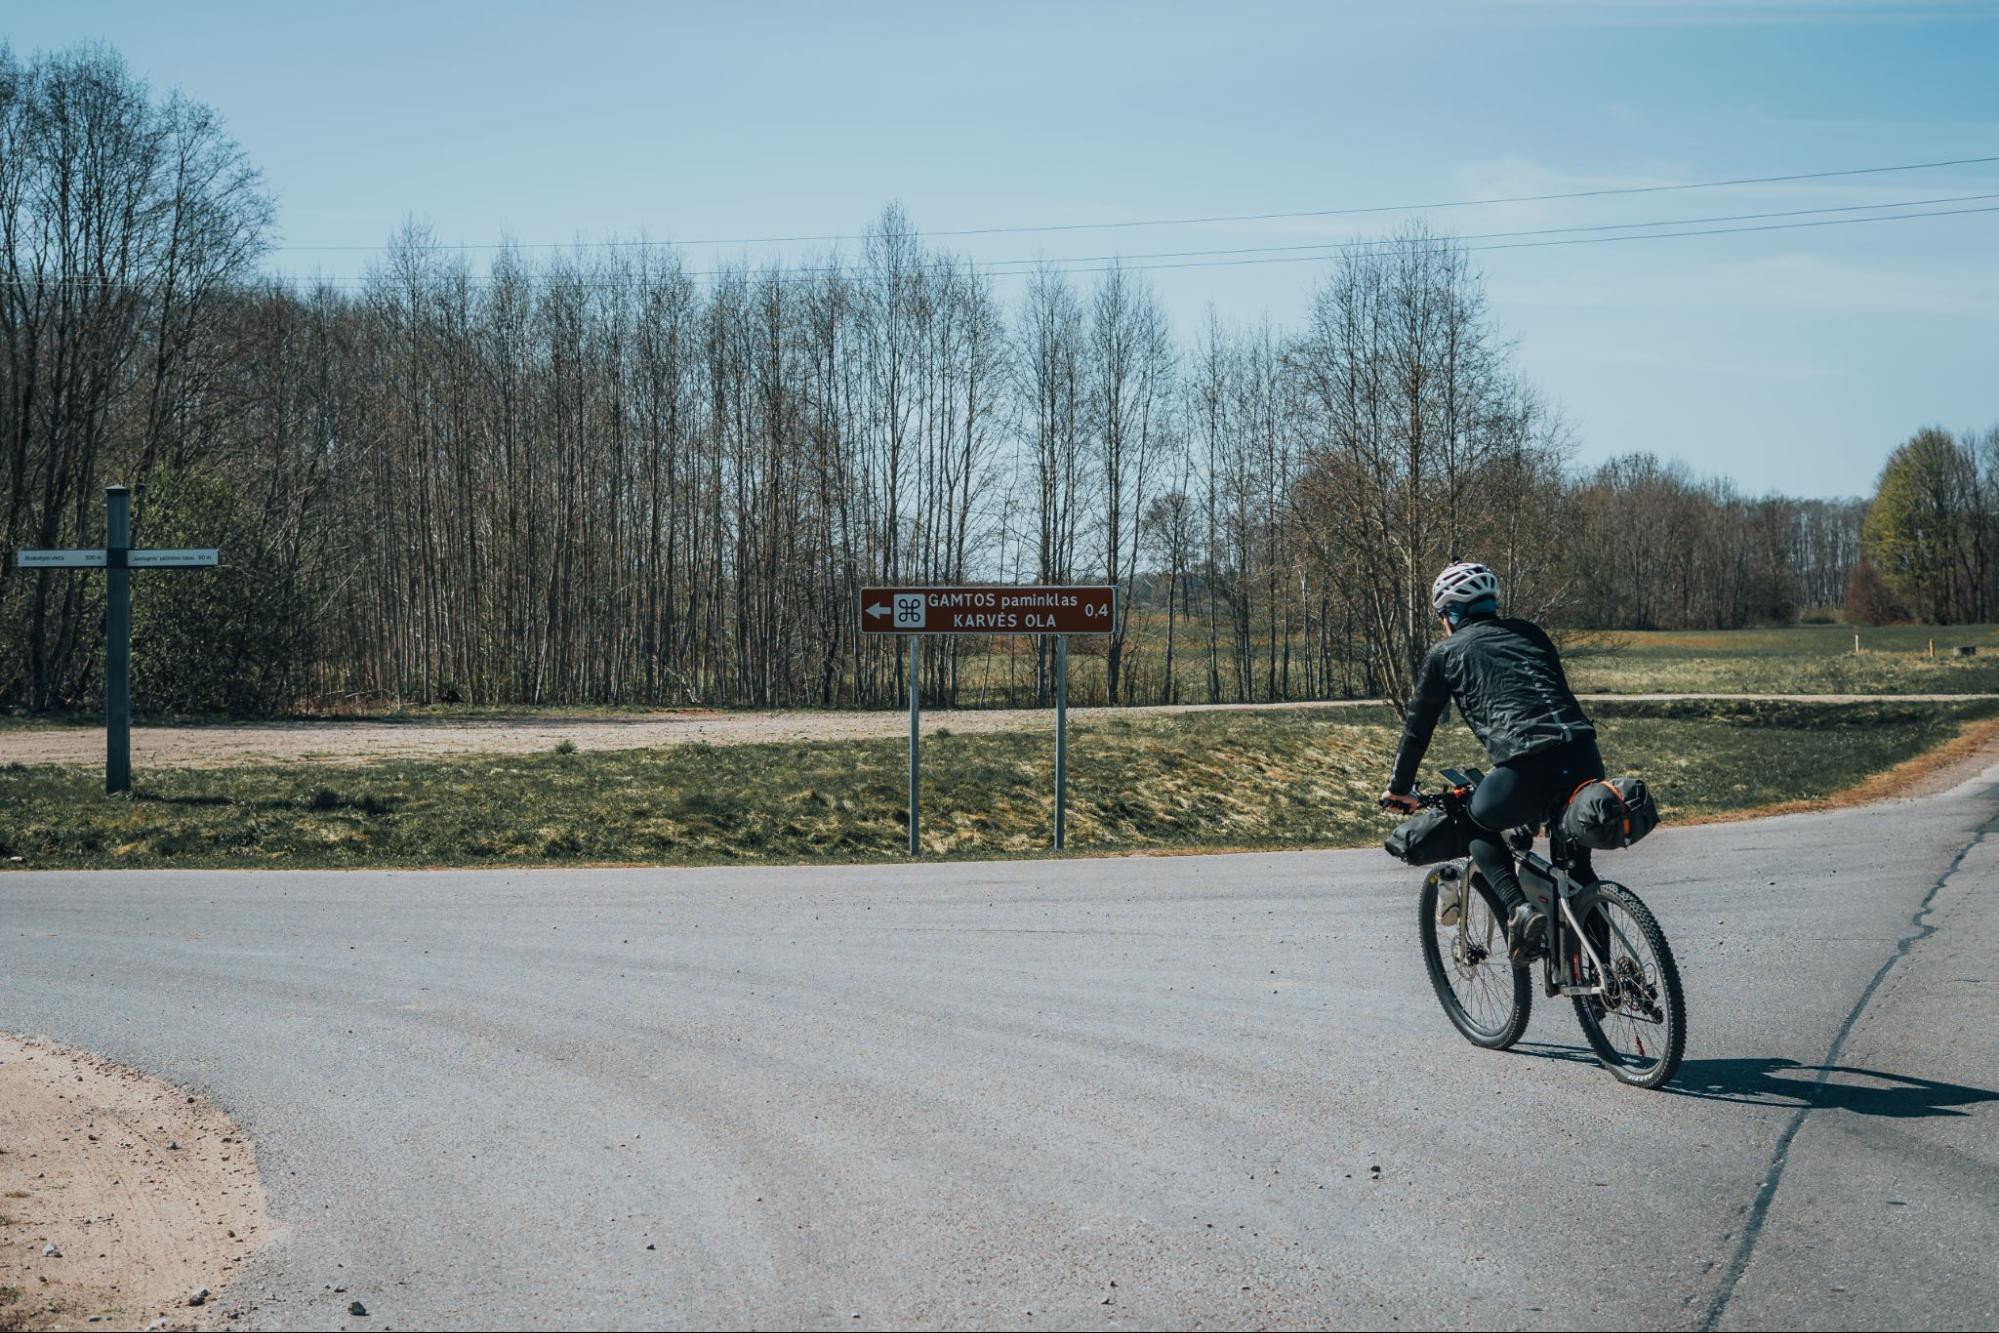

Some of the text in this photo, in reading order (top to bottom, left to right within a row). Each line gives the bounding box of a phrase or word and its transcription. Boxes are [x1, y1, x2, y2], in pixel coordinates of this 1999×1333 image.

[928, 593, 1078, 609] GAMTOS paminklas
[1085, 603, 1109, 619] 0,4
[953, 611, 1057, 628] KARVĖS OLA
